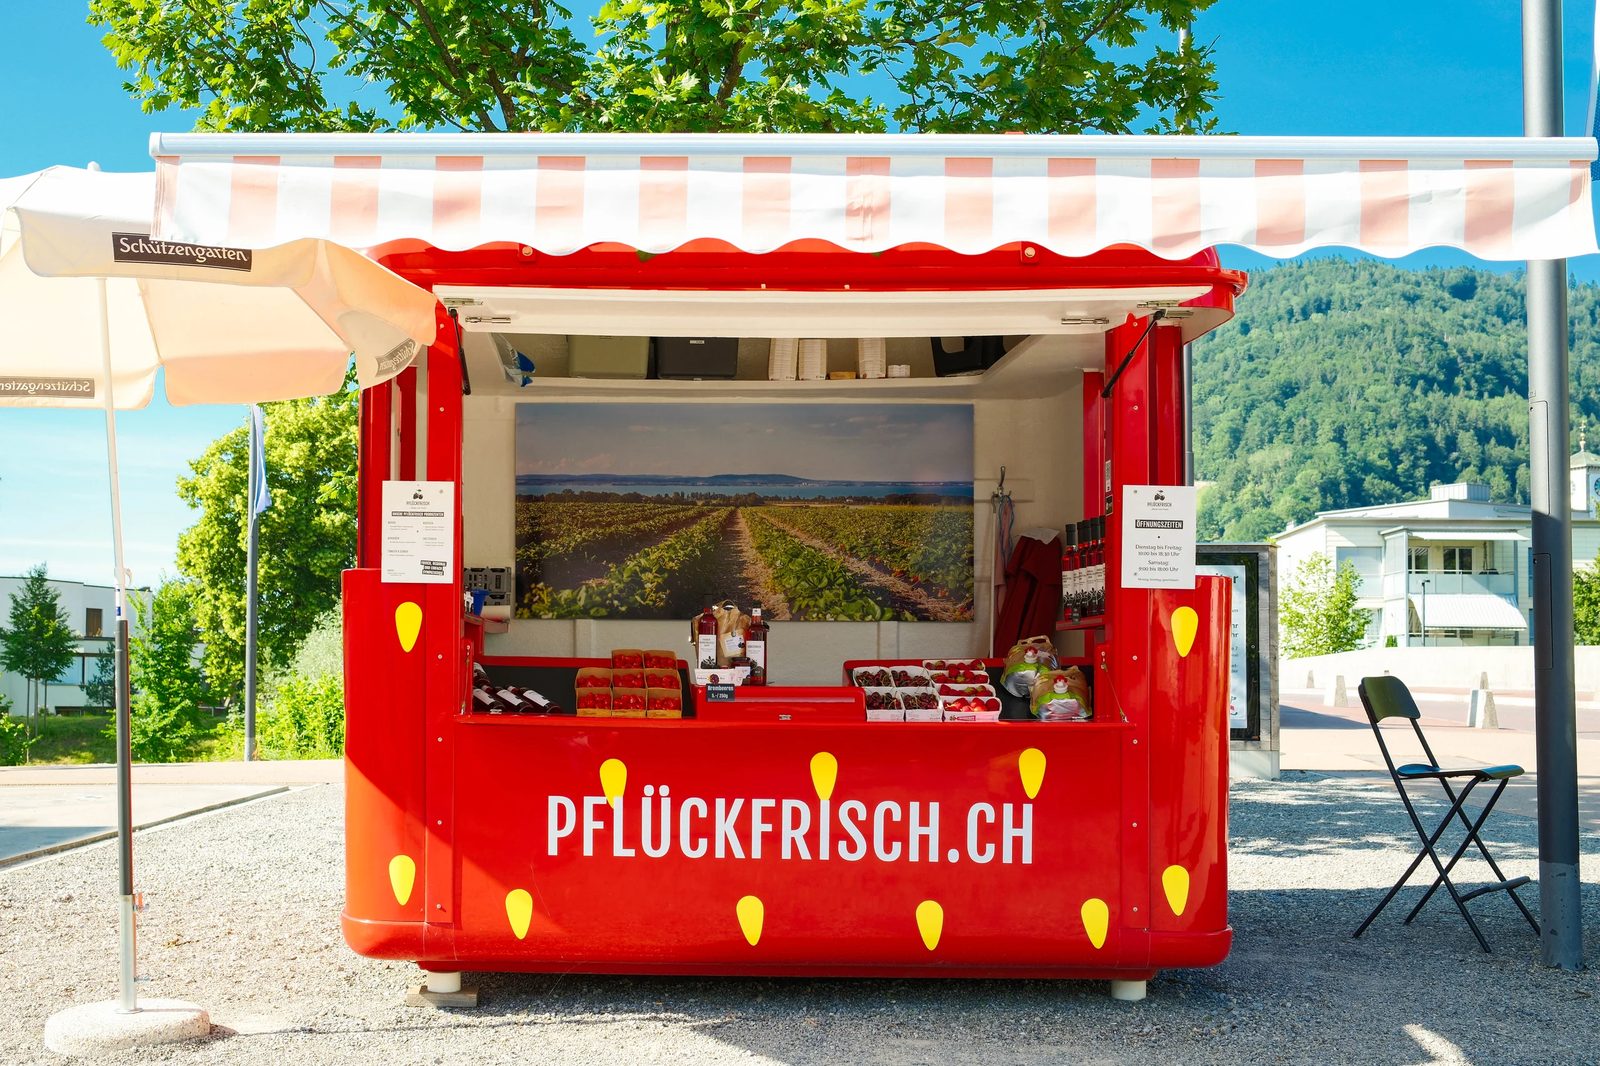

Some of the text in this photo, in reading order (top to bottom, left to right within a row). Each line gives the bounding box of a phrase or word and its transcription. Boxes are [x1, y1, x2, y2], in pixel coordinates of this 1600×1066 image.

[119, 237, 248, 263] Schützengarten
[1136, 520, 1182, 529] ÖFFNUNGSZEITEN
[547, 784, 1034, 864] PFLÜCKFRISCH.CH
